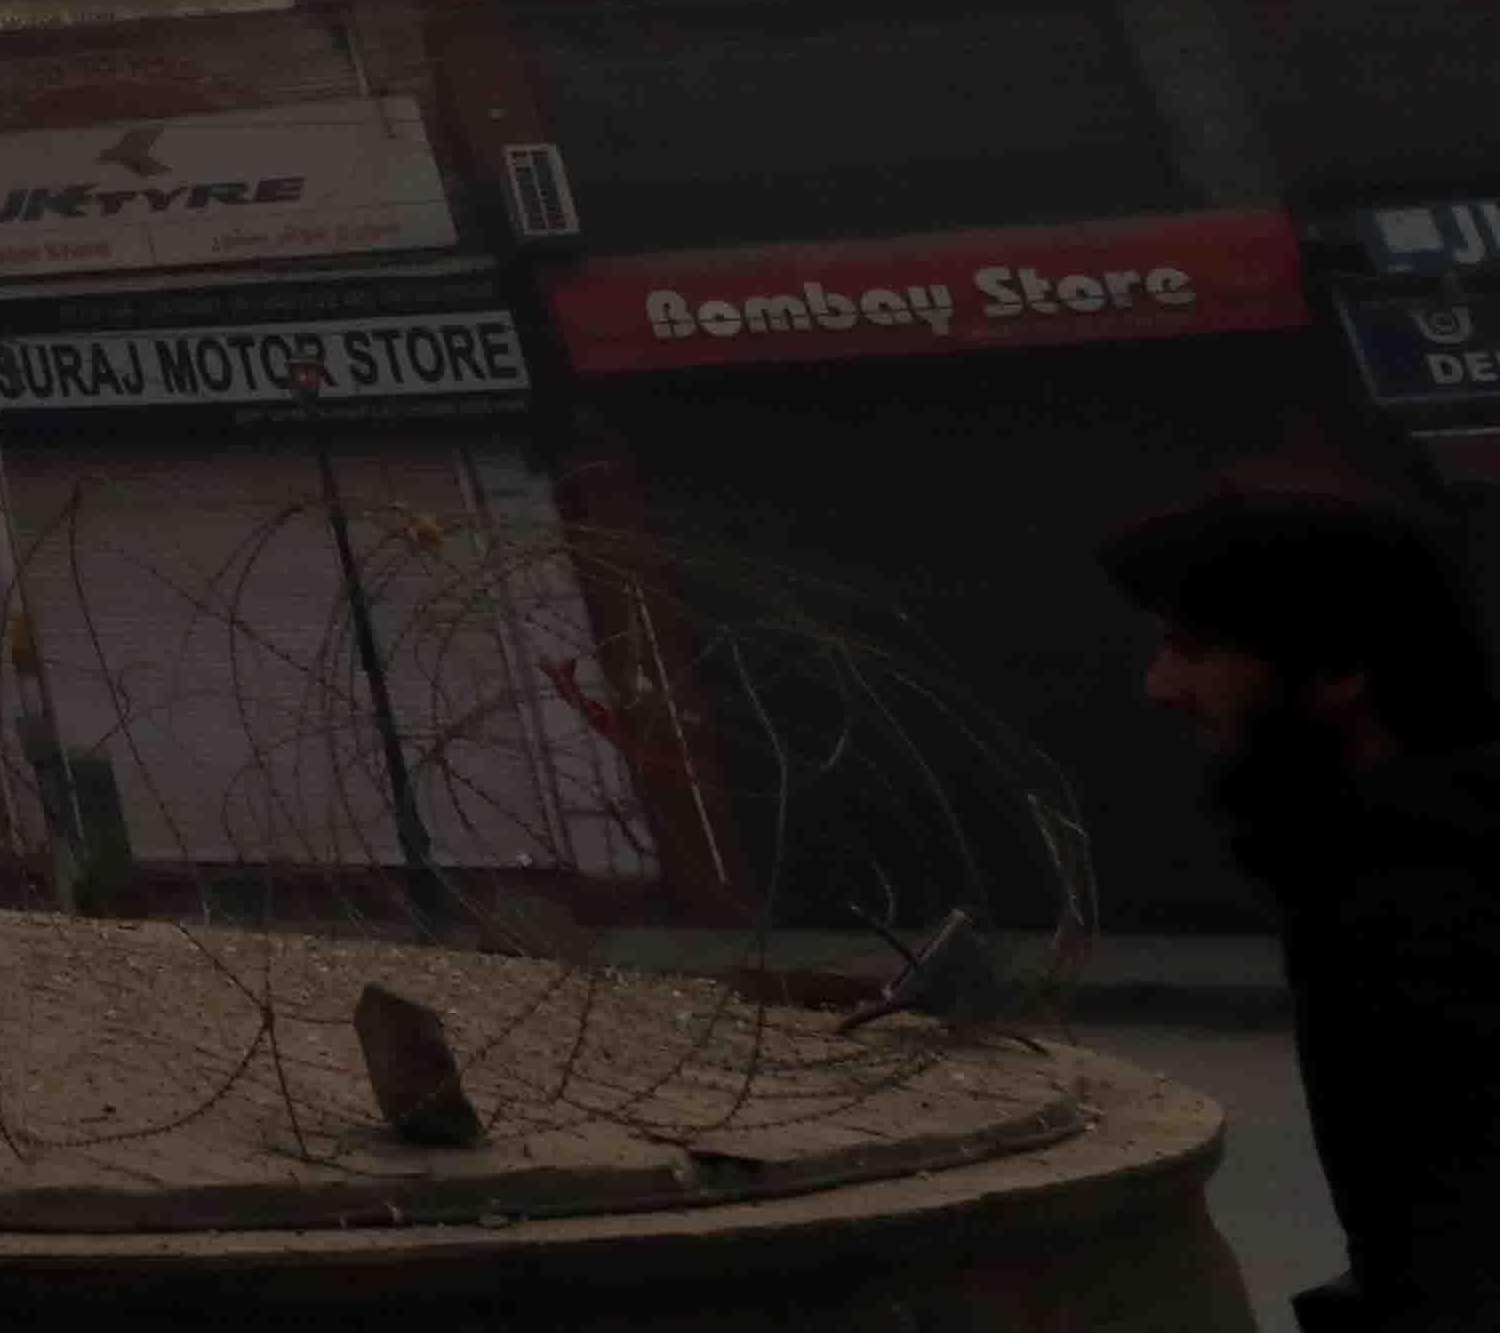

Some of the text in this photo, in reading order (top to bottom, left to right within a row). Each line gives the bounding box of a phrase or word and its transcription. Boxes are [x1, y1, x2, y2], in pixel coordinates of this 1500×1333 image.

[645, 263, 1198, 339] Bombay Store
[155, 331, 338, 395] MOTOR
[341, 321, 519, 388] STORE
[1427, 349, 1500, 385] DE
